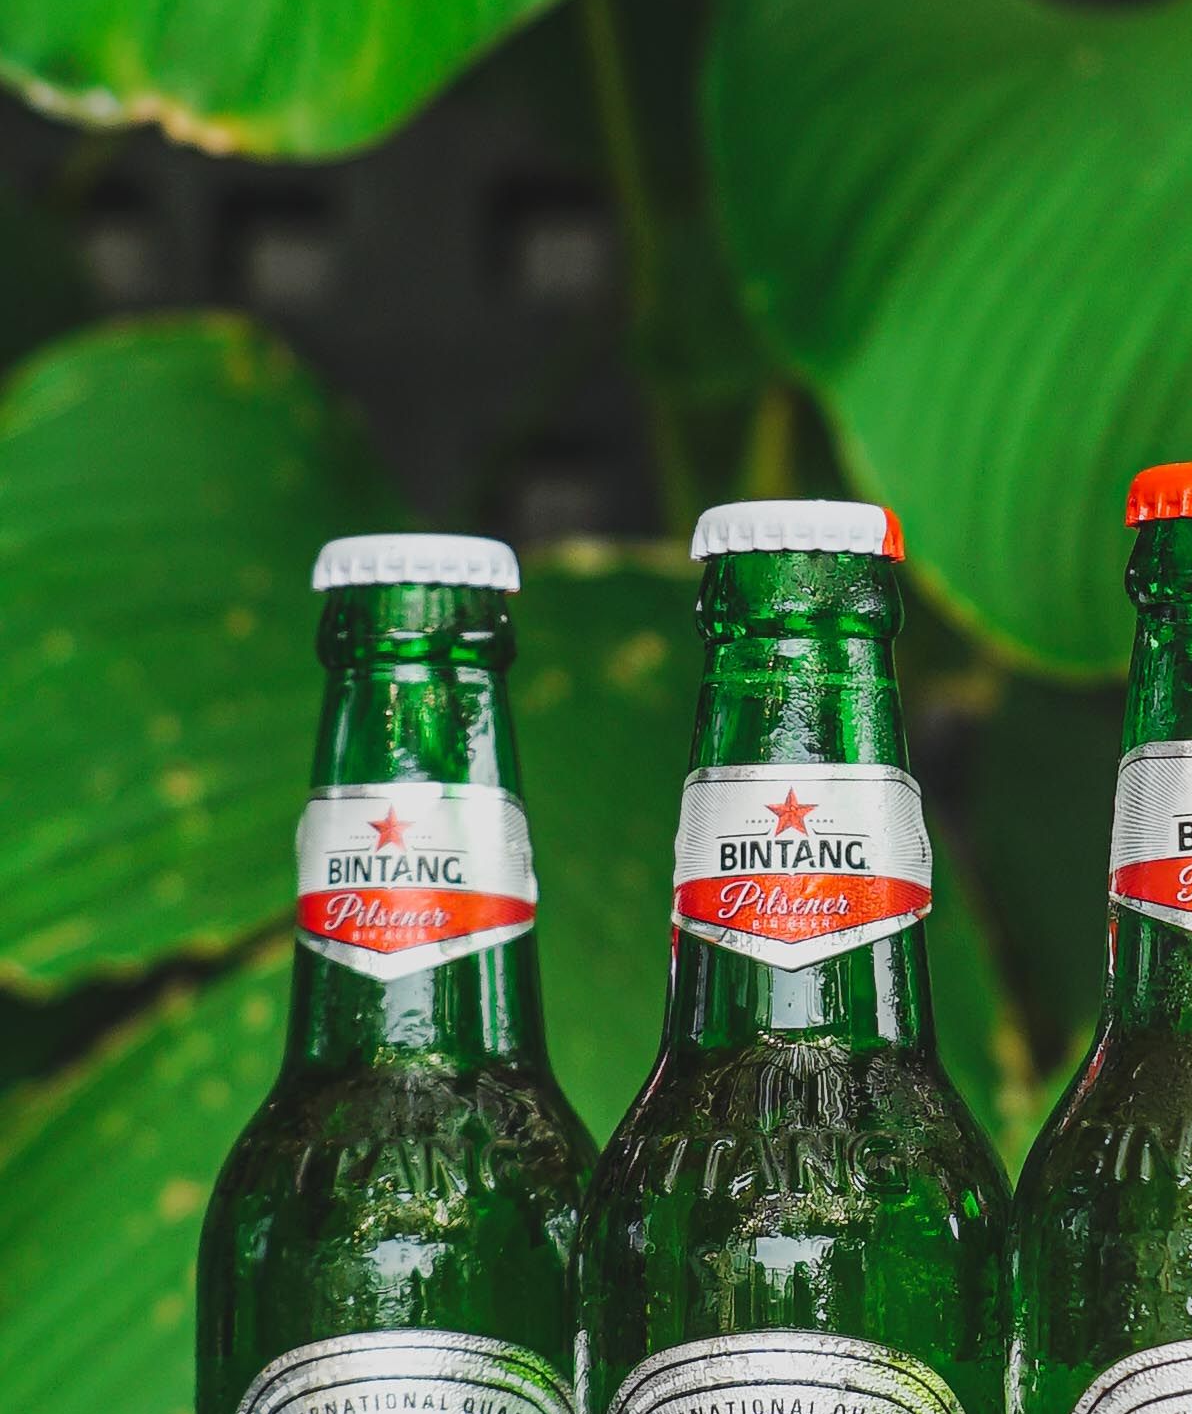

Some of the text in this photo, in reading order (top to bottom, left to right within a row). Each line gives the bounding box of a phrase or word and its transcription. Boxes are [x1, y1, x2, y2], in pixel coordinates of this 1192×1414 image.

[327, 855, 464, 885] BINTANG
[720, 839, 866, 871] BINTANG
[324, 893, 449, 931] Pilsener
[717, 880, 849, 919] Pilsener
